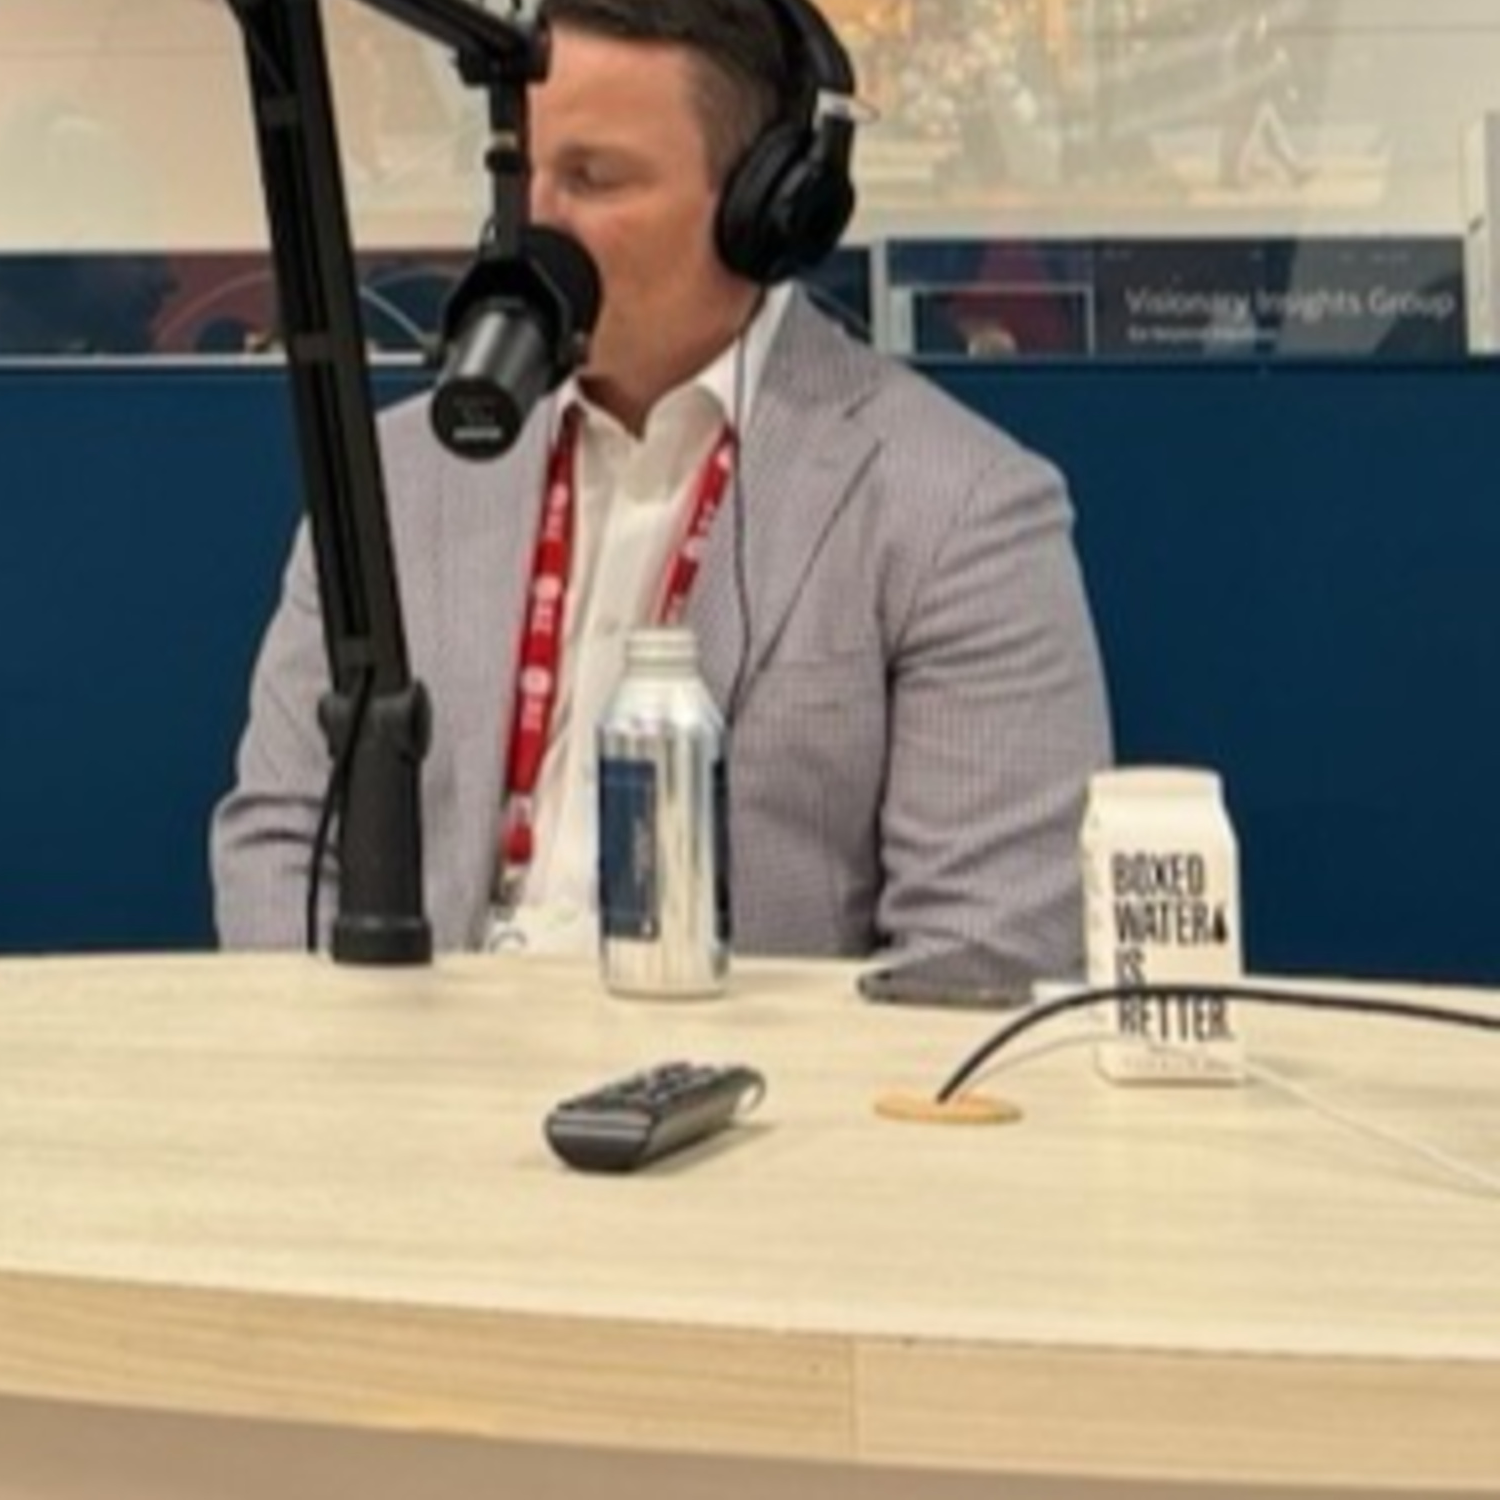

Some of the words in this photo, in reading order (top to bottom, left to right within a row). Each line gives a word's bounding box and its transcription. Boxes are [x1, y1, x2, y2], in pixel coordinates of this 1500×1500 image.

[1369, 285, 1455, 319] Group
[1111, 852, 1205, 897] BOXED
[1113, 902, 1211, 946] WATER
[1115, 947, 1146, 986] IS
